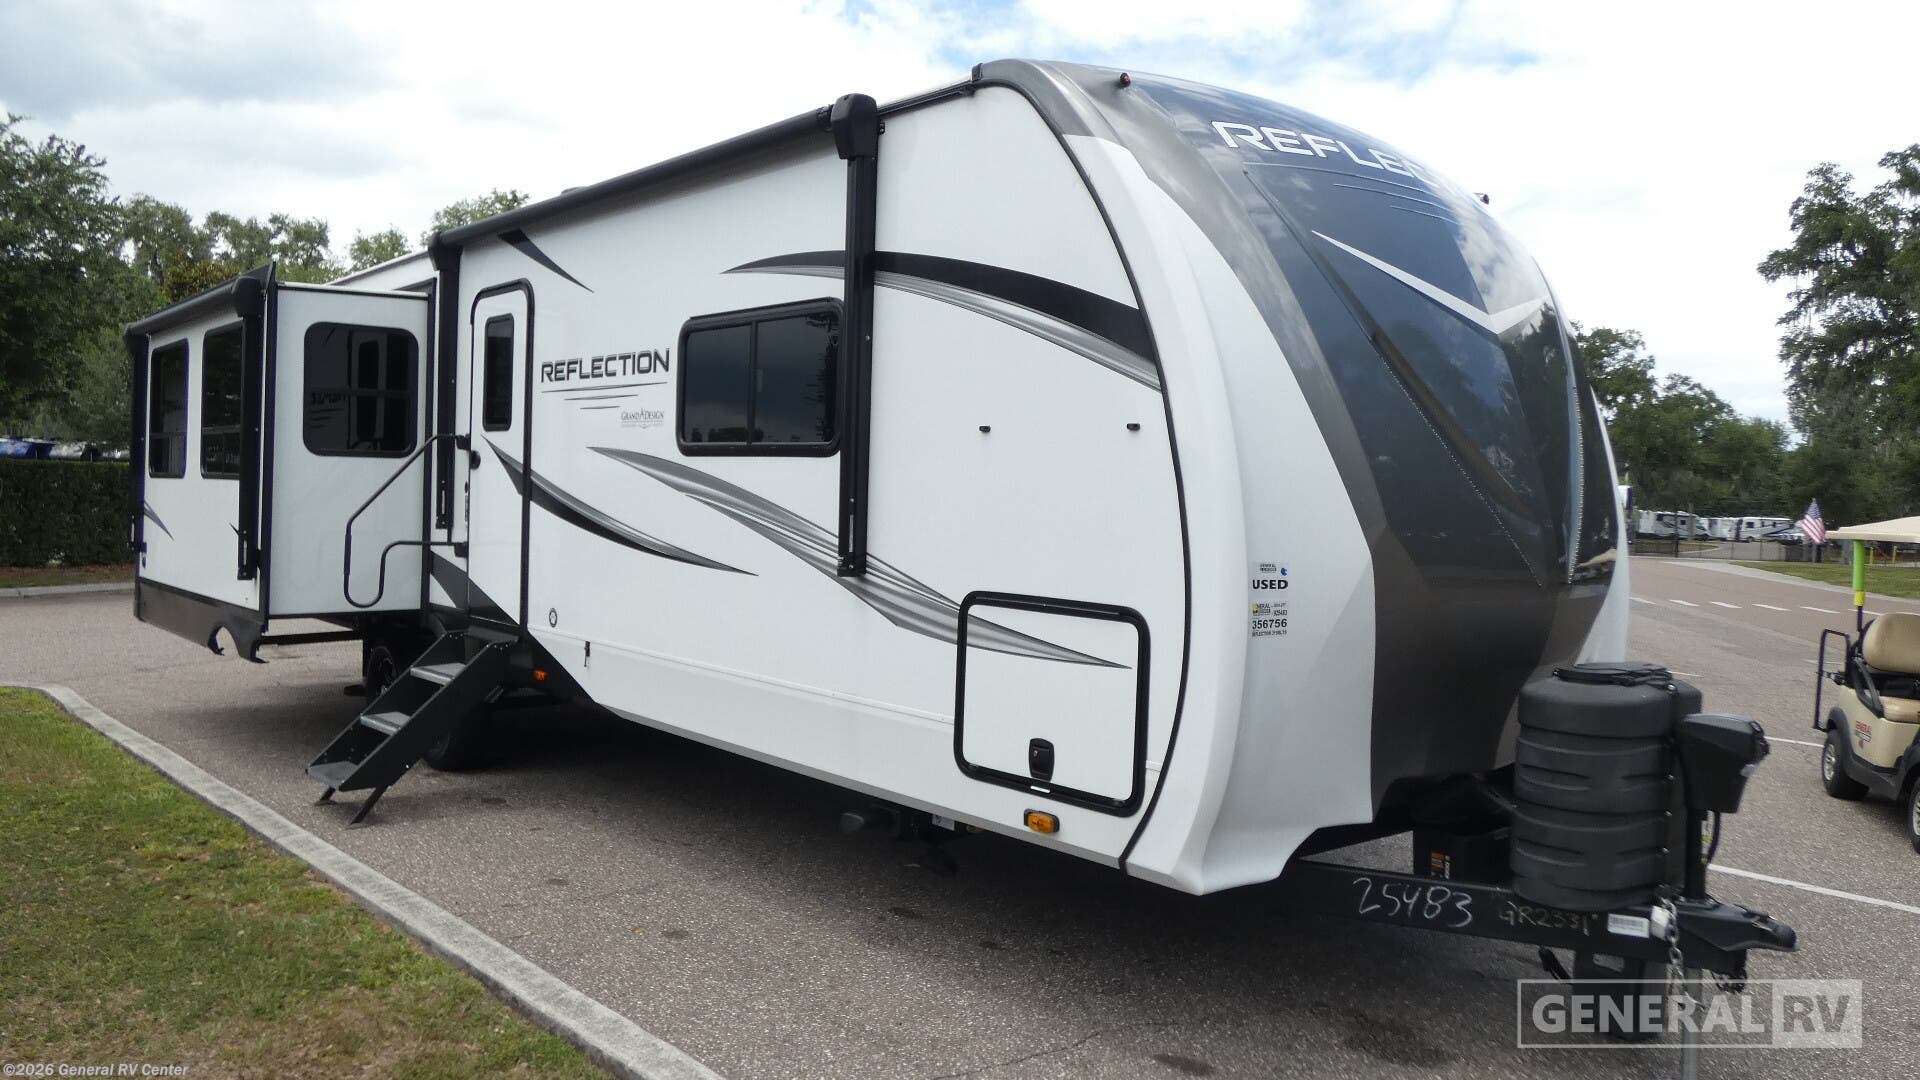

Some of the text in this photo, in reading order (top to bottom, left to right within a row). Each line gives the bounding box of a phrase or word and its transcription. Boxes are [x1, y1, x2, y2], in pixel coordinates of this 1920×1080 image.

[541, 348, 670, 383] REFLECTION
[1252, 579, 1289, 590] USED
[1252, 618, 1288, 630] 356756
[1352, 877, 1473, 928] 25483
